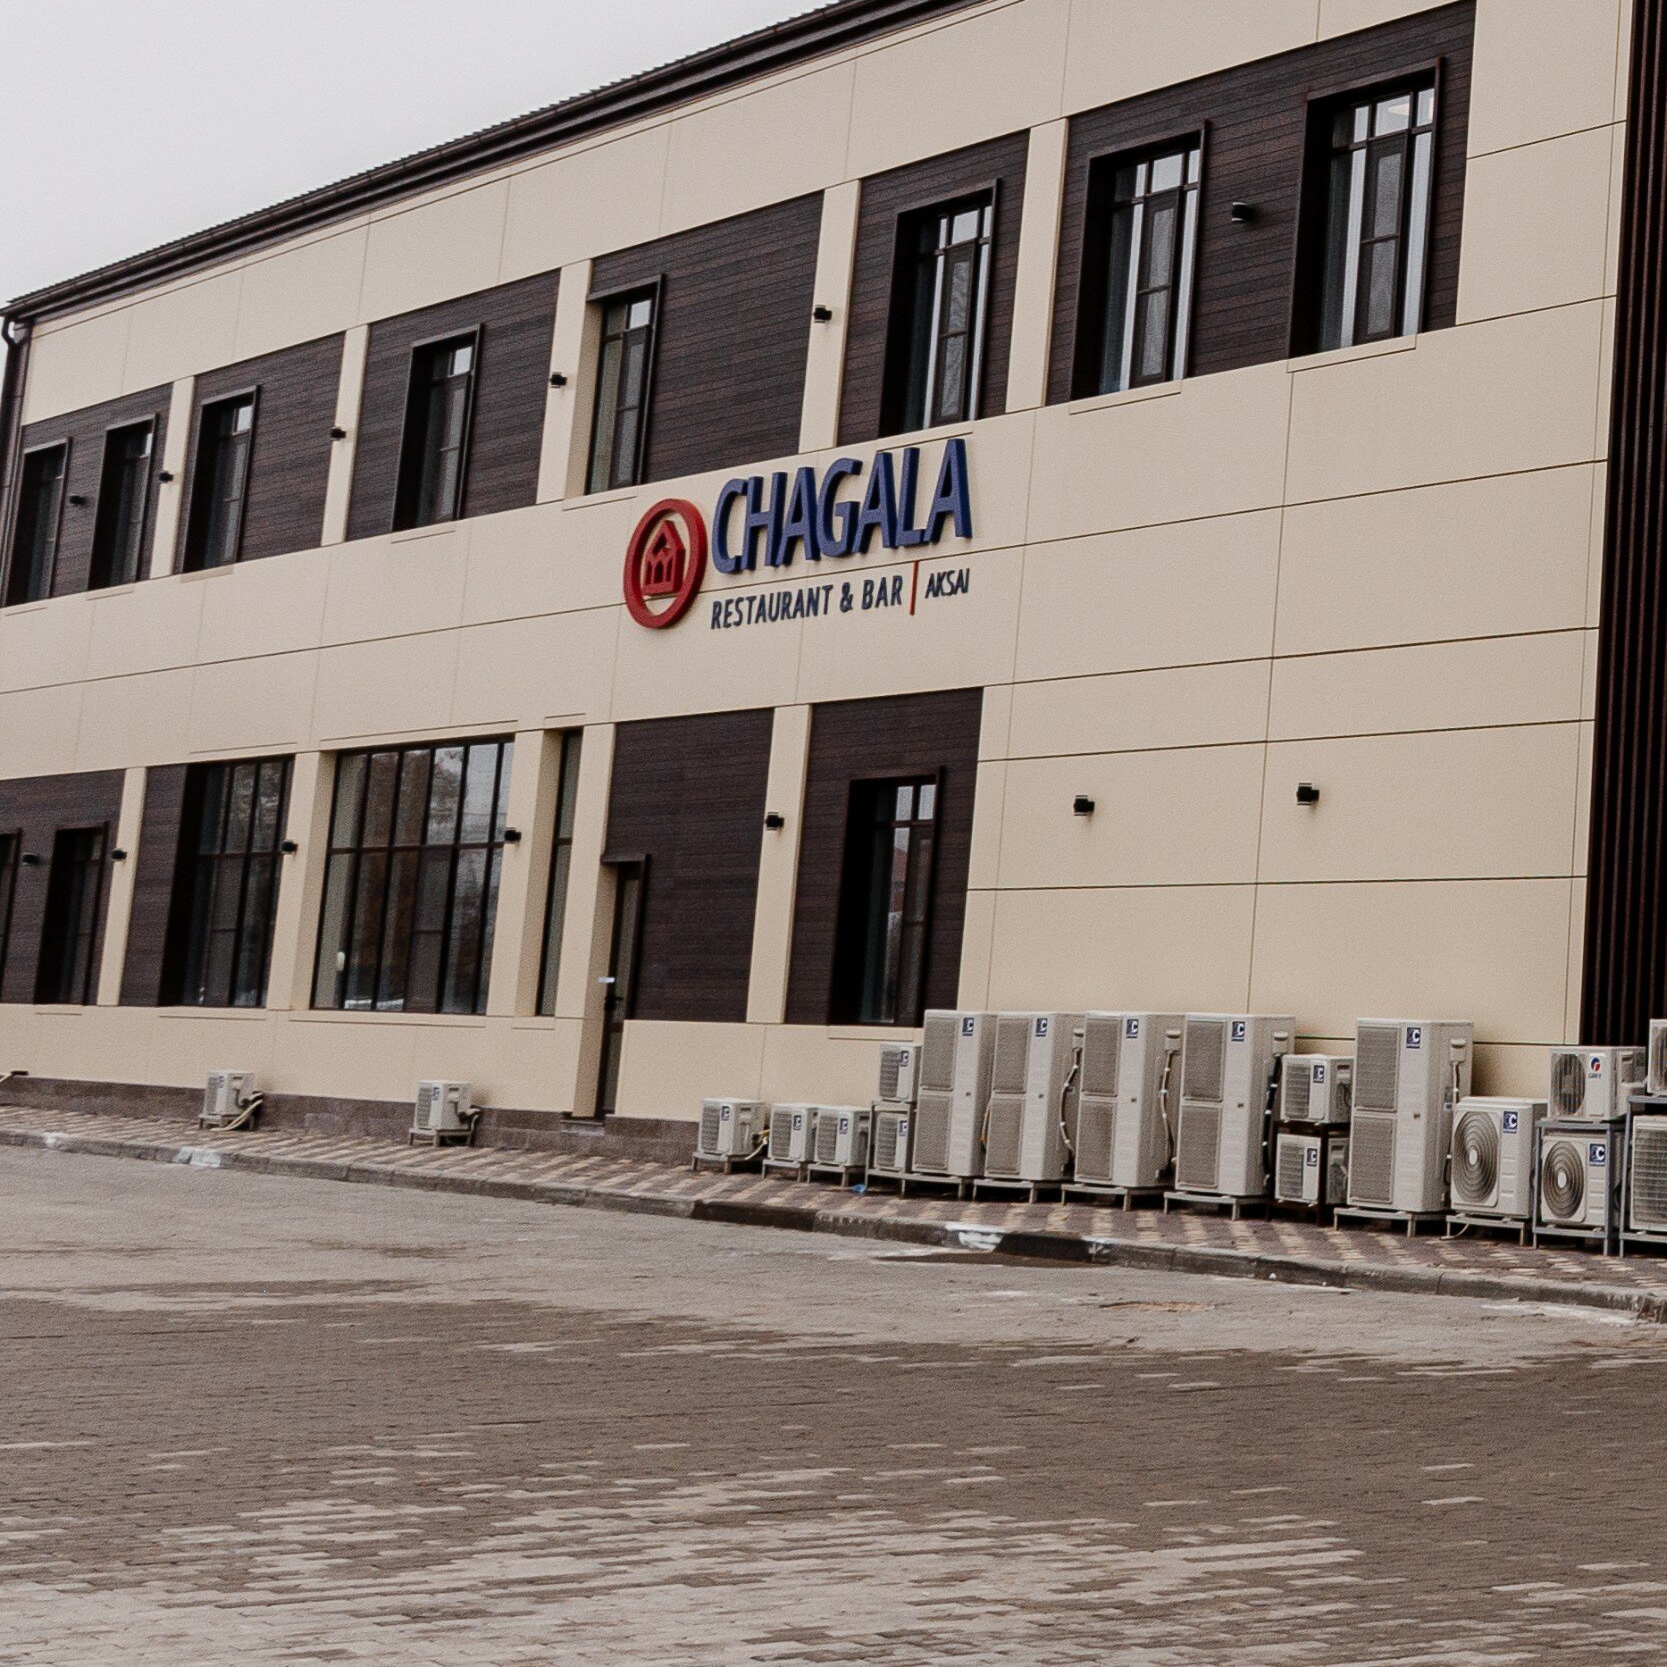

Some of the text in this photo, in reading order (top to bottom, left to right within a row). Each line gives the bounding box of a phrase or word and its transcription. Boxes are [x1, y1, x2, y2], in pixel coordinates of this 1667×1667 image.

[711, 438, 973, 574] CHAGALA
[710, 567, 970, 630] RESTAURANT & BAR AKSAI
